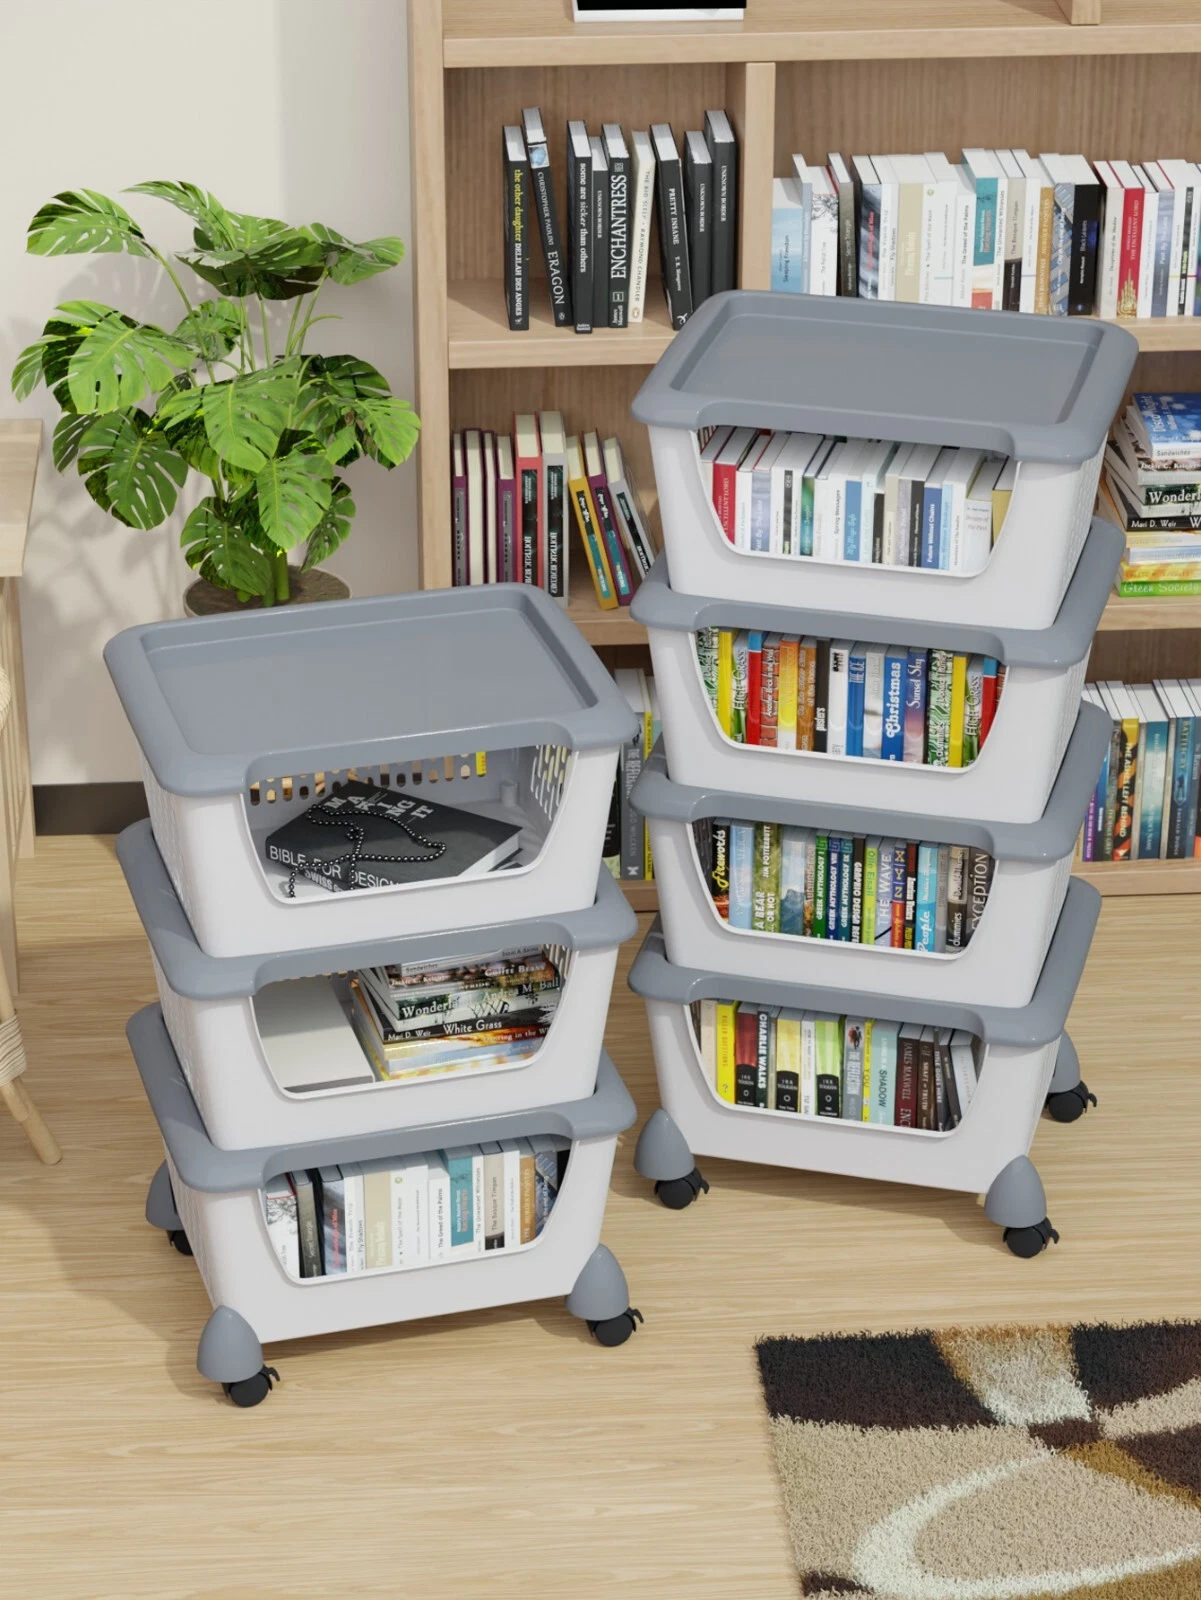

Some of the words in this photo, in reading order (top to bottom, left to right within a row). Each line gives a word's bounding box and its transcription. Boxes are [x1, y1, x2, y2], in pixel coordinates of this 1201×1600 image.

[514, 169, 523, 182] the
[514, 184, 523, 205] other
[668, 188, 678, 216] PRETTY
[512, 206, 523, 242] daughter
[579, 201, 587, 227] sicker
[610, 174, 627, 279] ENCHANTRESS
[537, 171, 551, 218] CHRISTOPHER
[547, 250, 565, 305] ERAGON
[579, 228, 587, 246] than
[671, 217, 680, 245] INSANE
[579, 248, 587, 273] others
[1148, 489, 1201, 504] Wonder
[907, 658, 925, 677] Sky
[885, 662, 901, 738] Christmas
[906, 681, 921, 709] Sunset
[1121, 786, 1130, 804] LEFT
[1119, 805, 1128, 837] BEHIND
[269, 845, 306, 866] BIBLE
[711, 829, 729, 889] Fireworks
[816, 855, 825, 898] MYTHOLOGY
[829, 866, 838, 908] MYTHOLOGY
[841, 863, 850, 906] MYTHOLOGY
[852, 861, 862, 896] GRAPHIC
[879, 853, 892, 893] WAVE
[755, 891, 766, 919] BEAR
[816, 898, 824, 920] GREEK
[852, 897, 861, 925] DESIGN
[878, 899, 890, 925] THE
[755, 921, 765, 930] A
[828, 909, 837, 930] GREEK
[948, 912, 962, 947] dummies
[540, 977, 559, 989] Ball
[443, 1022, 473, 1035] White
[475, 1019, 502, 1031] Grass
[758, 1013, 768, 1056] CHARLIE
[903, 1042, 912, 1064] JAMES
[757, 1056, 767, 1089] WALKS
[902, 1065, 912, 1100] MAXWELL
[879, 1069, 887, 1107] SHADOW
